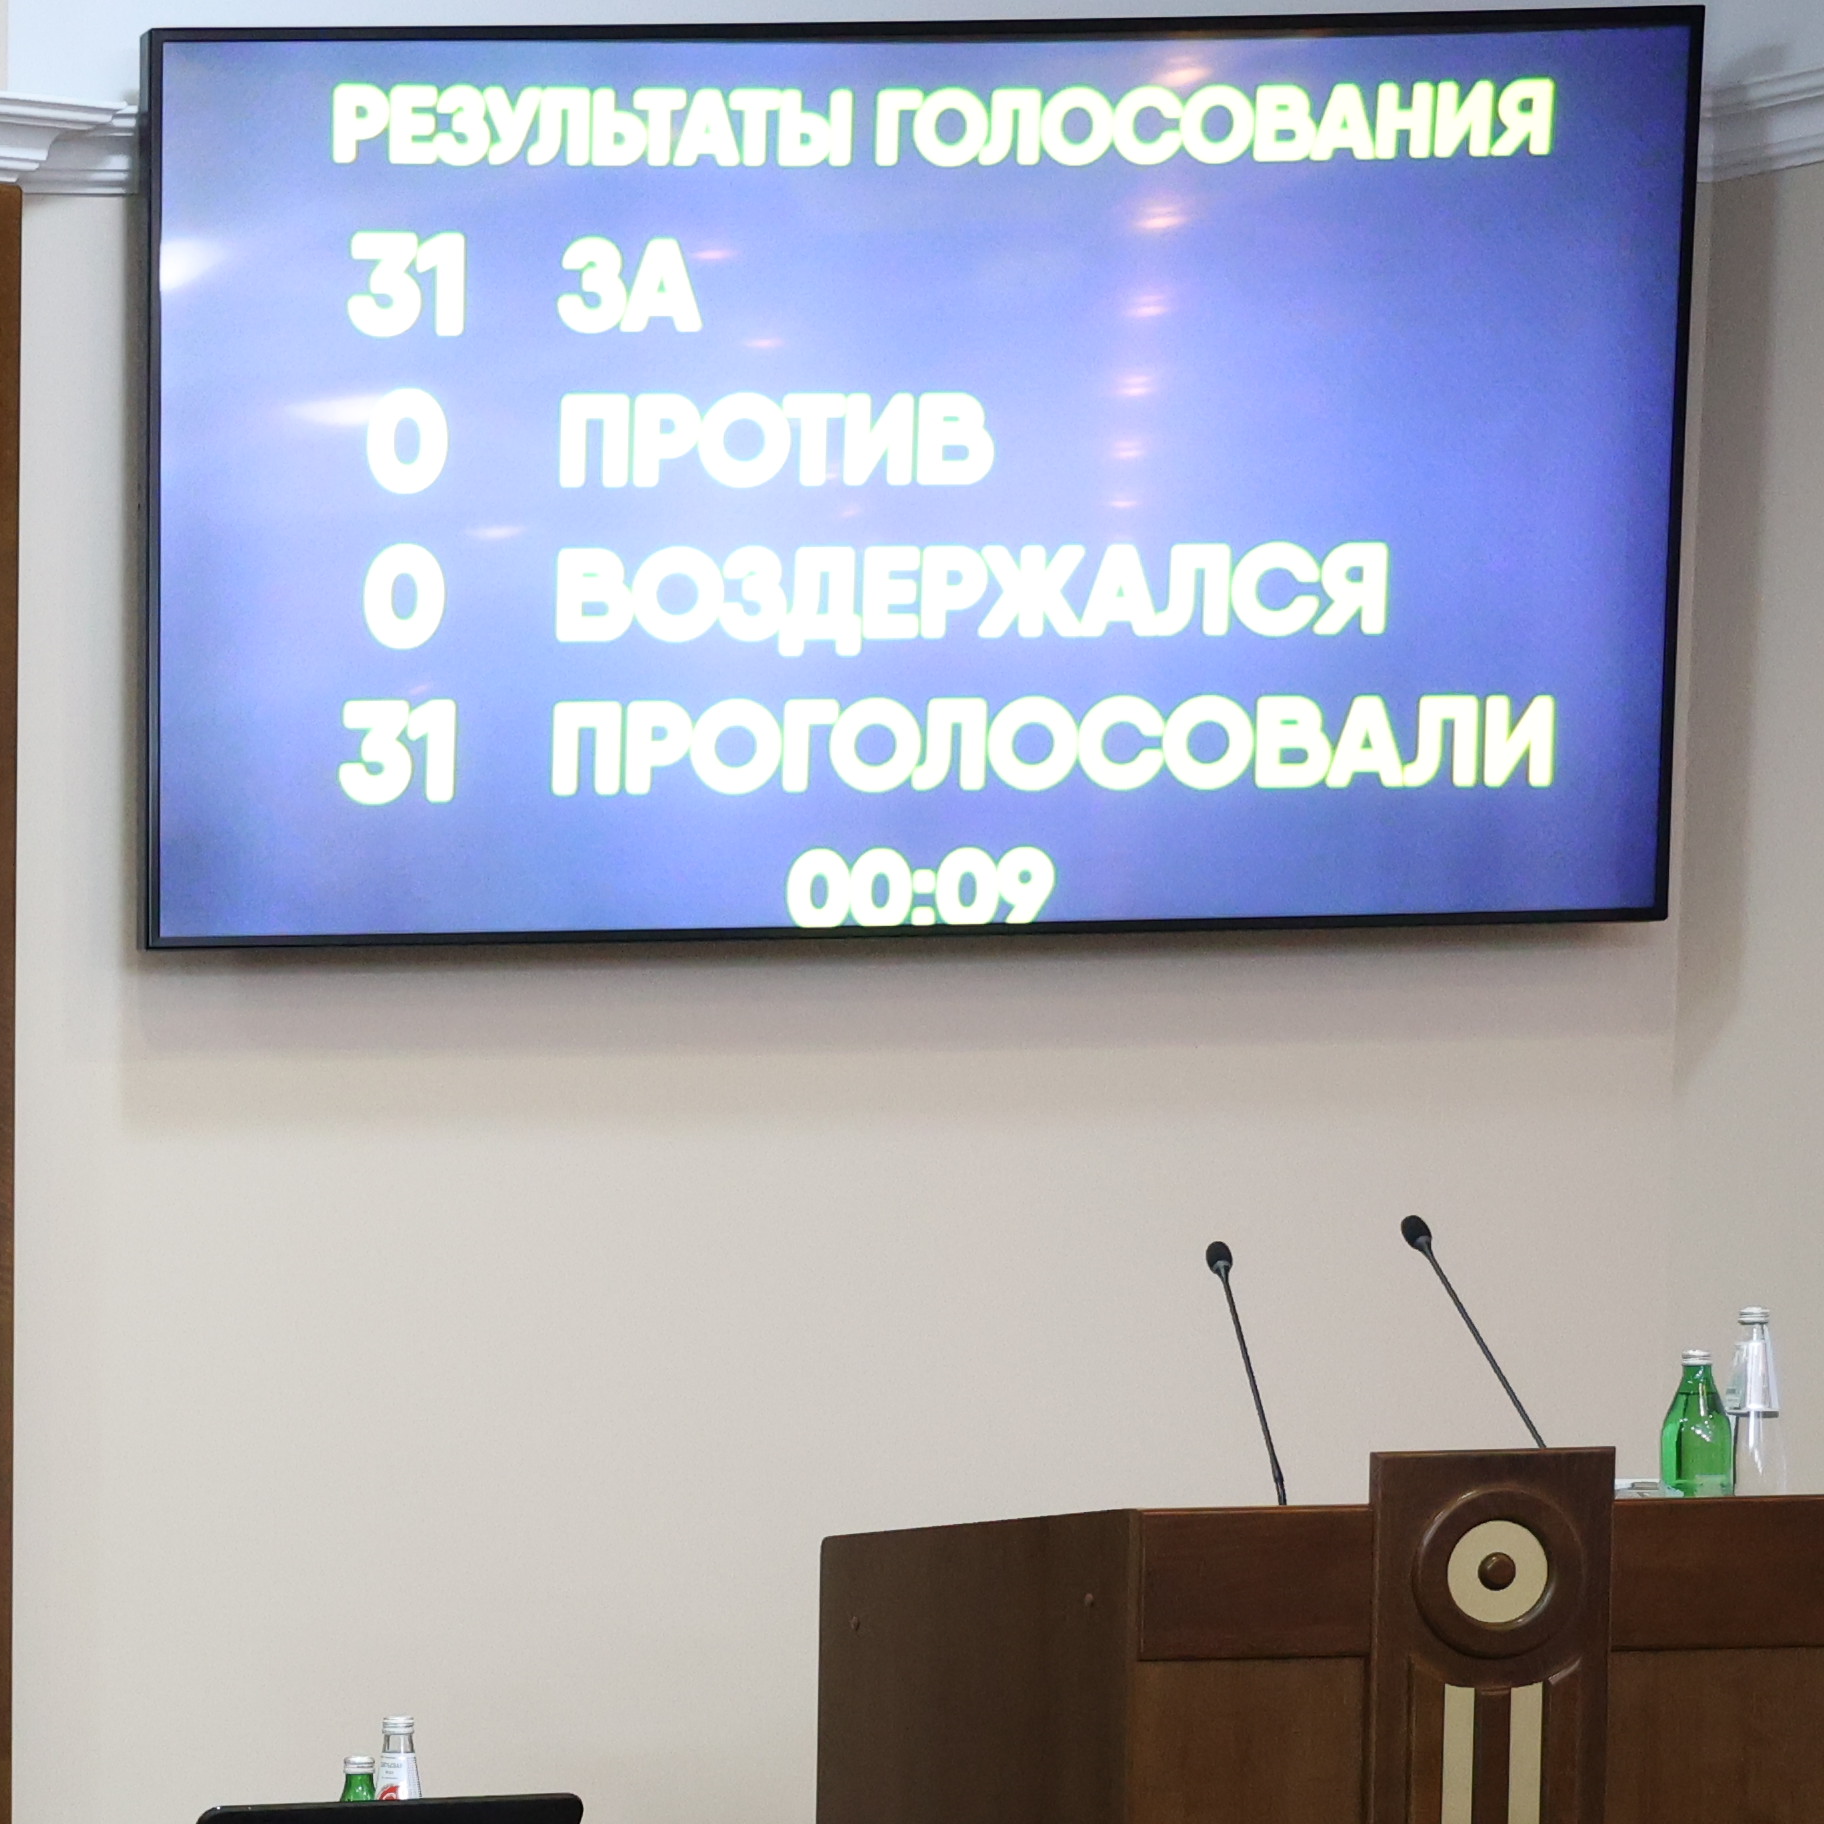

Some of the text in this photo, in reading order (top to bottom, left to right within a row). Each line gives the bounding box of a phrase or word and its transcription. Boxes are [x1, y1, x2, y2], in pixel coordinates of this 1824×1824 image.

[331, 77, 1555, 168] РЕЗУЛЬТАТЫ ГОЛОСОВАНИЯ
[347, 230, 703, 338] 31 ЗА
[366, 387, 995, 493] 0 ПРОТИВ
[363, 541, 1390, 658] 0 ВОЗДЕРЖАЛСЯ
[338, 694, 1556, 806] 31 ПРОГОЛОСОВАЛИ
[785, 846, 1056, 929] 00:09
